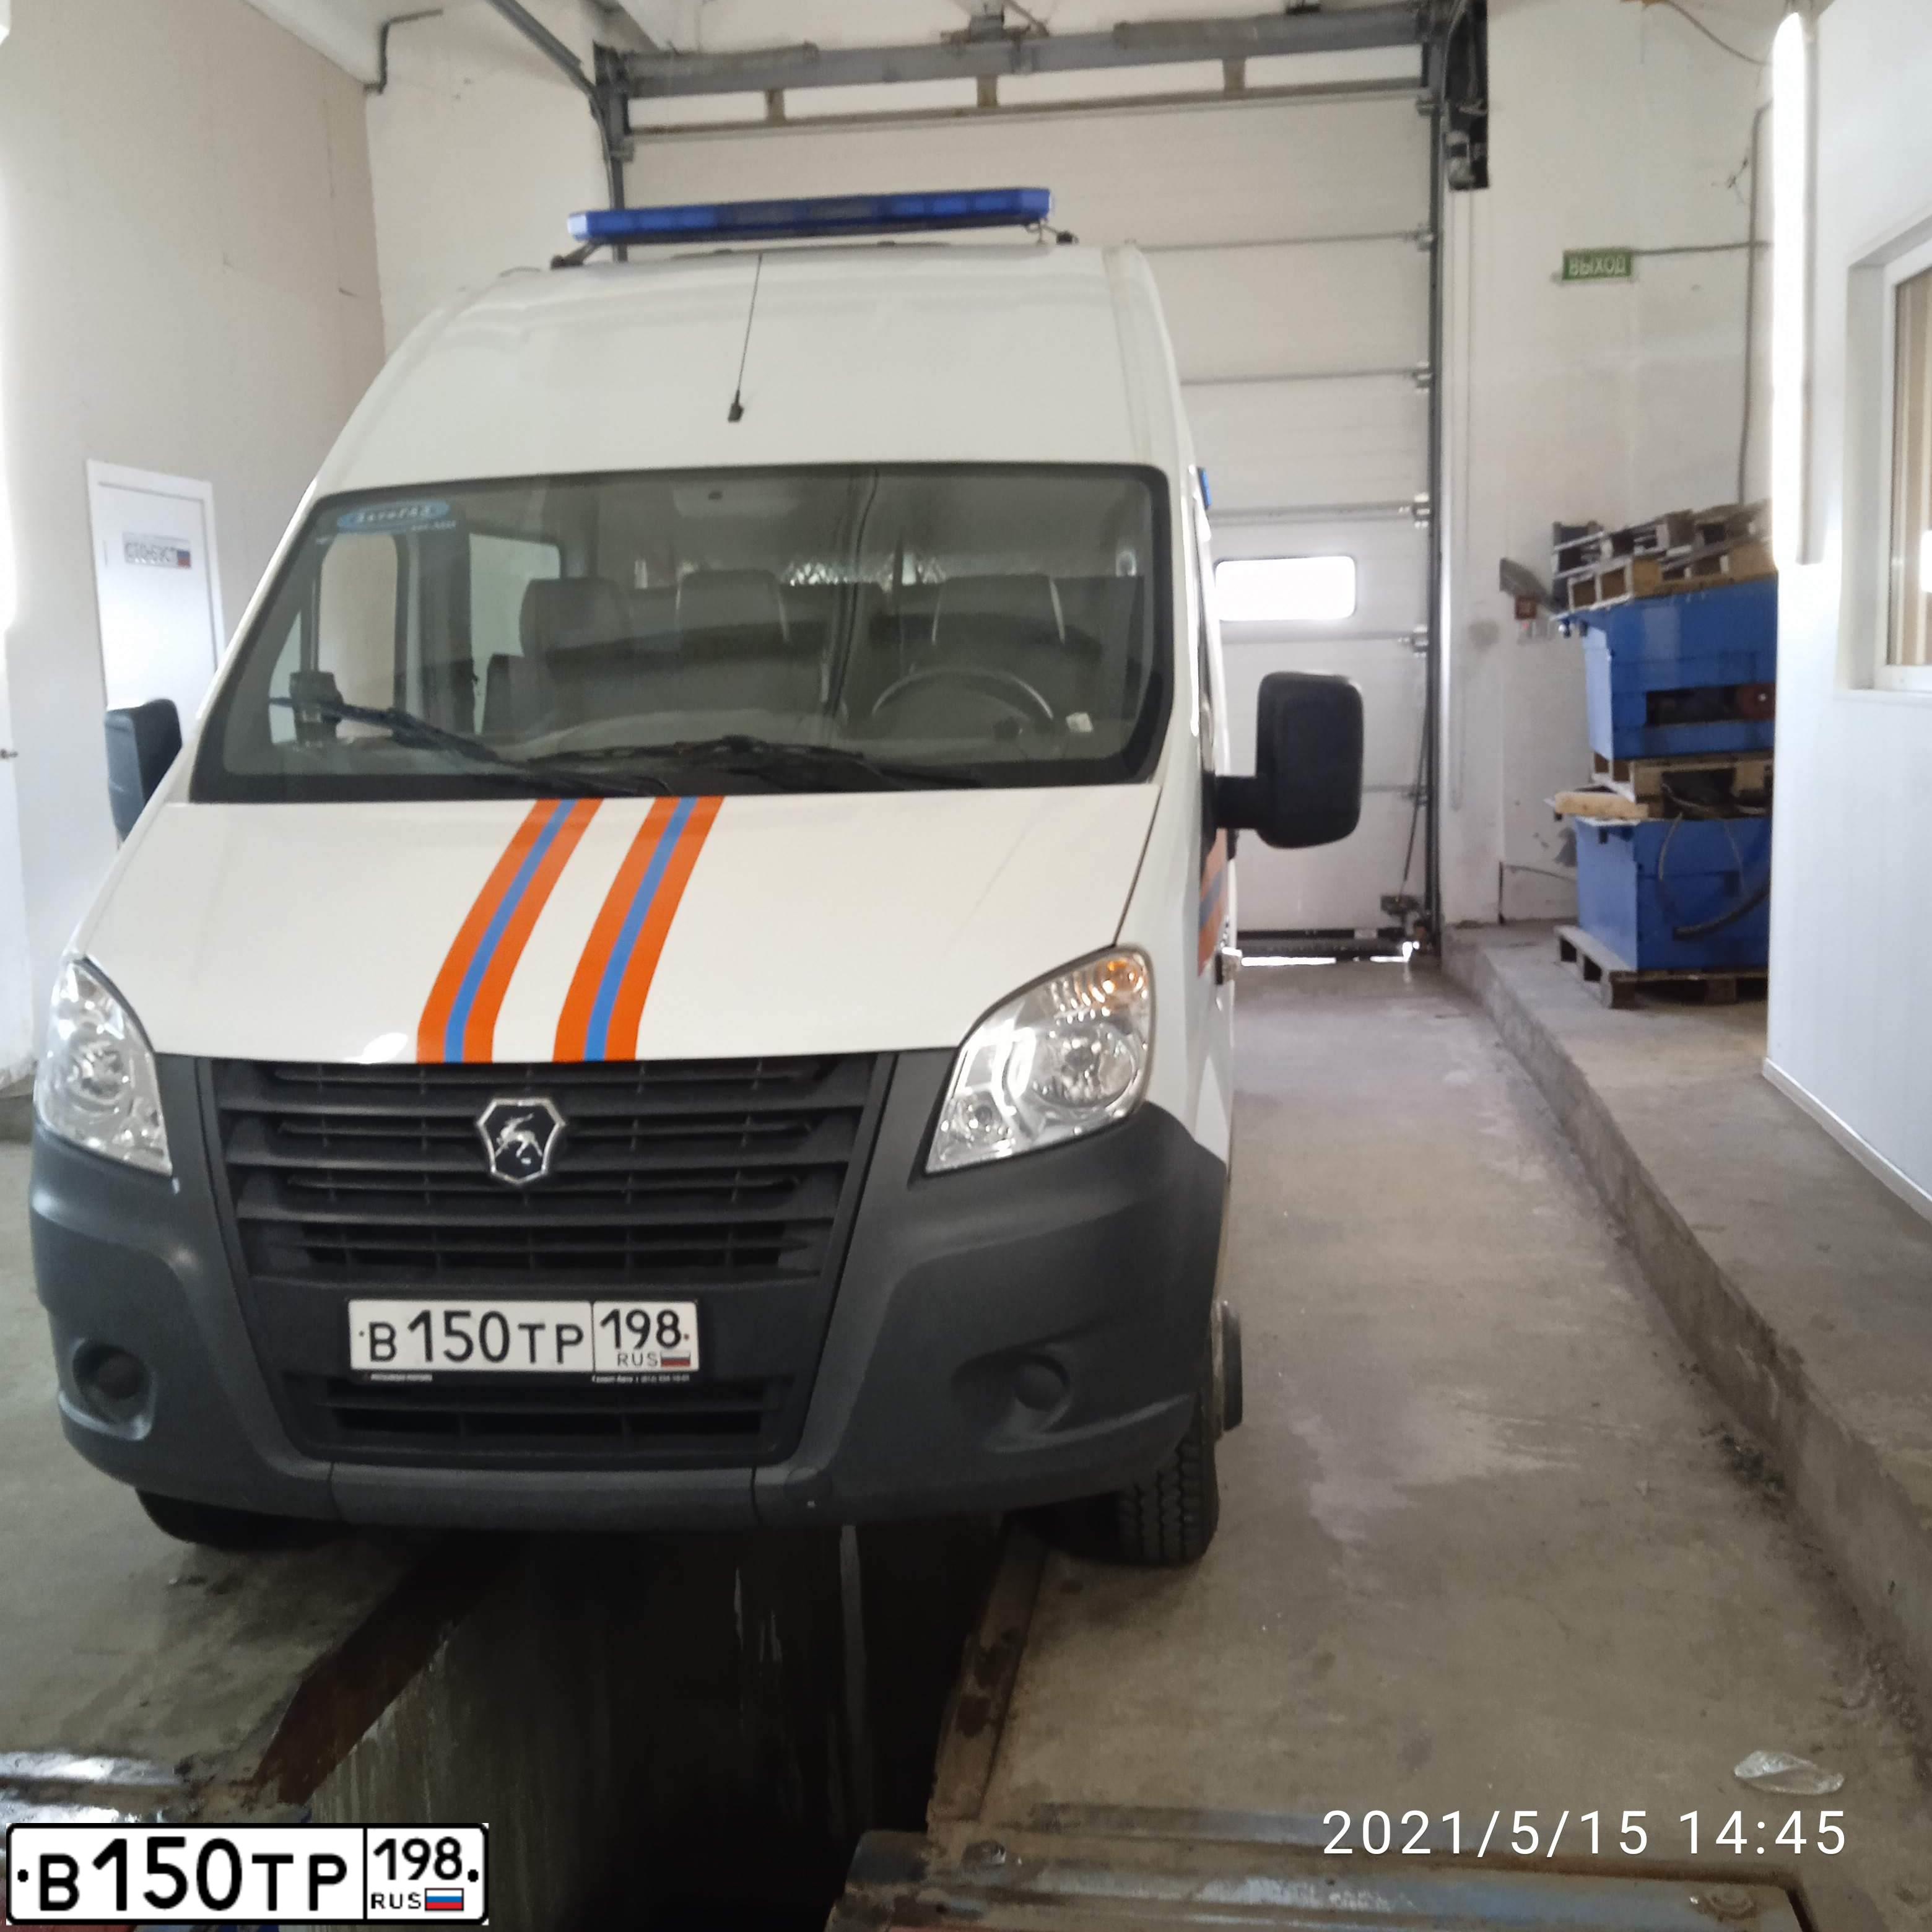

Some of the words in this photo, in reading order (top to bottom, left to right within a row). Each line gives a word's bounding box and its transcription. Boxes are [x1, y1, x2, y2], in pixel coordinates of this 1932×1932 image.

[1569, 255, 1626, 275] ВЫХОД
[369, 1310, 583, 1364] В150ТР
[600, 1308, 682, 1349] 198
[617, 1352, 658, 1367] RUS
